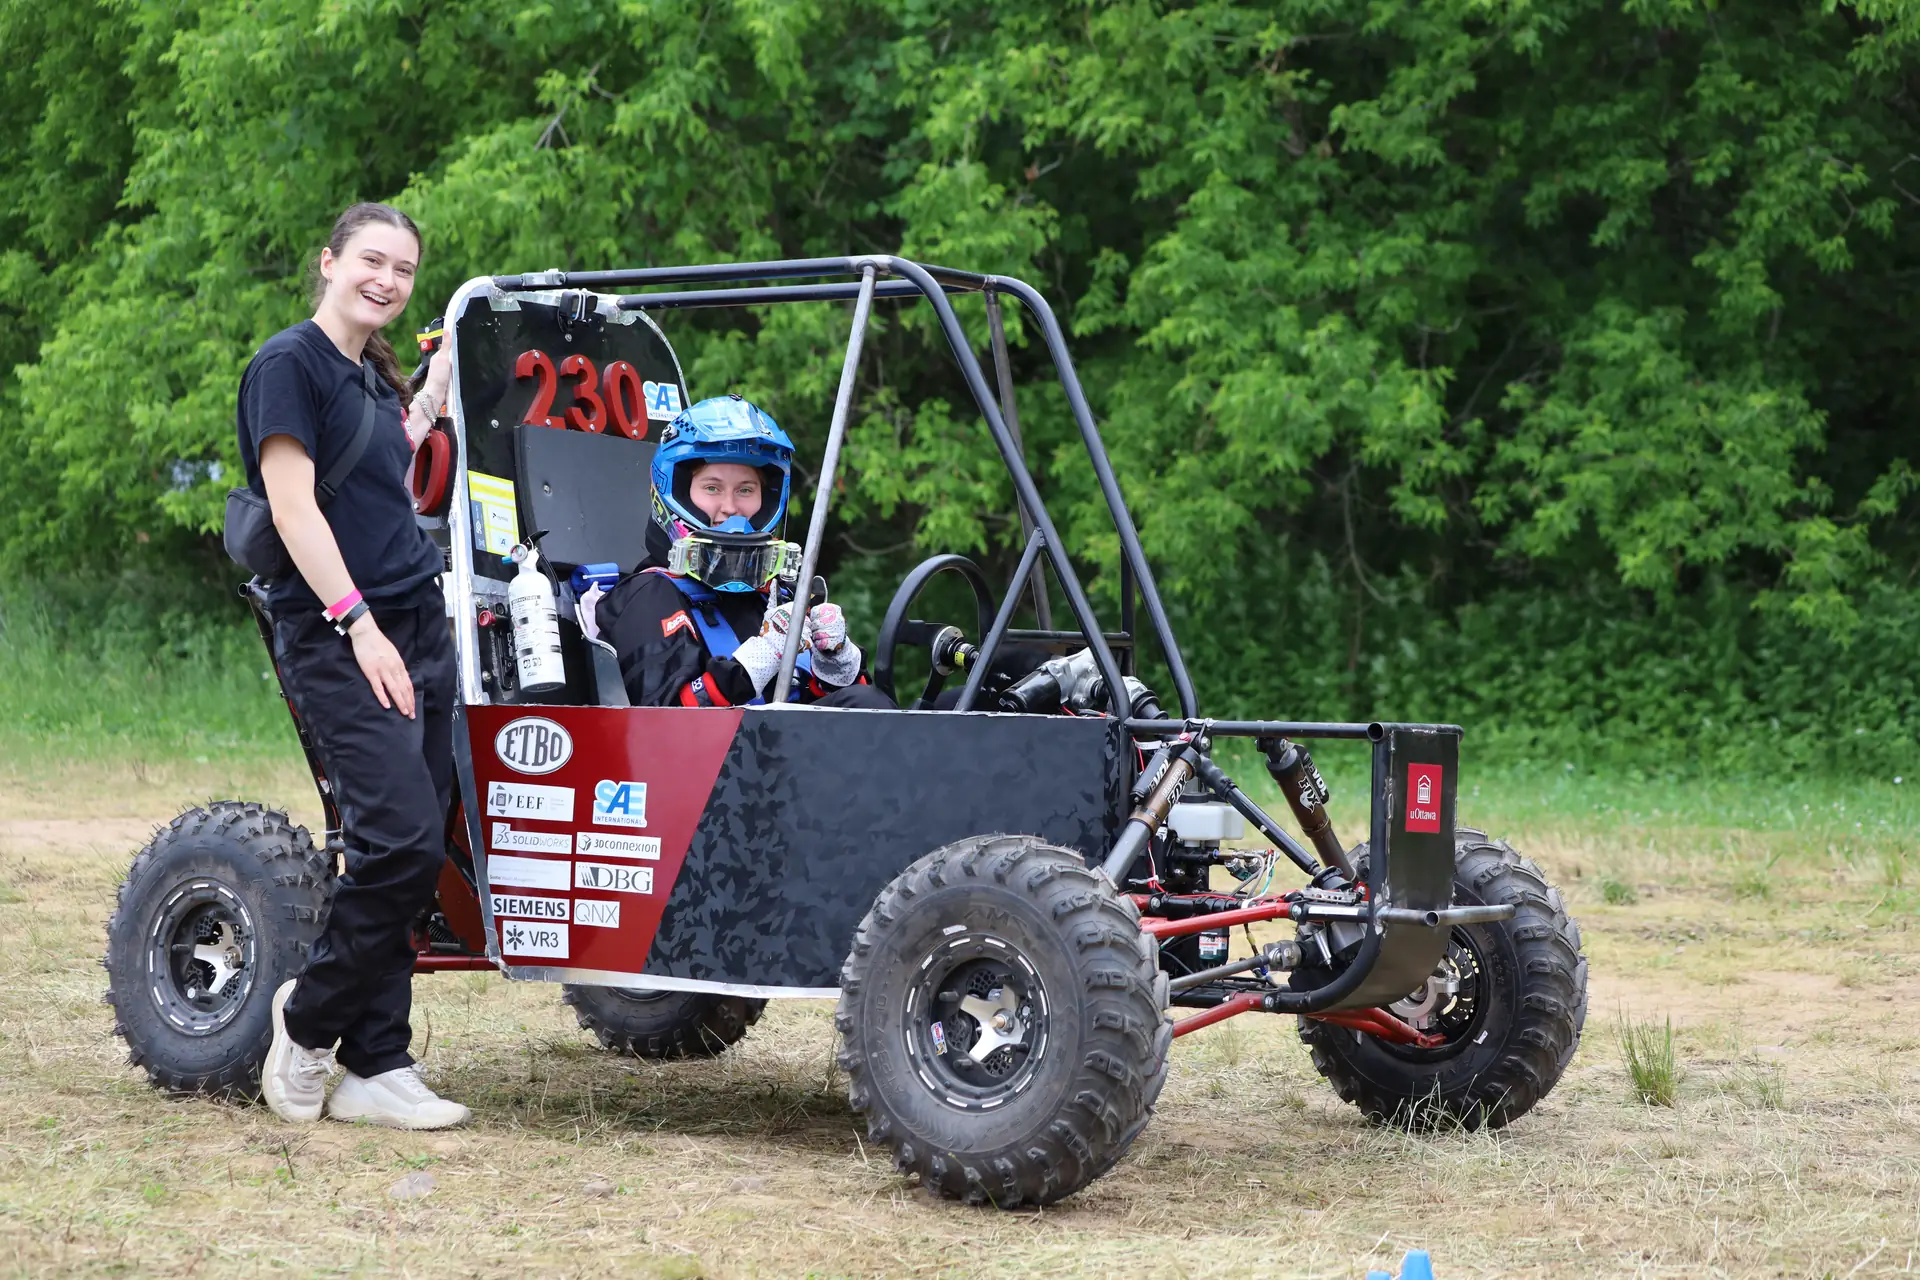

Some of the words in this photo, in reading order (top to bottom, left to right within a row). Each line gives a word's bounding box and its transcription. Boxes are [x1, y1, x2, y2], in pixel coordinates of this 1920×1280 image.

[515, 349, 648, 440] 230
[644, 382, 681, 412] SAE
[503, 725, 563, 766] ETBO
[595, 782, 645, 816] SAE
[1167, 771, 1188, 808] FOX
[1298, 776, 1320, 805] FOX
[516, 795, 544, 810] EEF
[1410, 808, 1437, 820] uOttawa
[595, 816, 643, 825] INTERNATIONAL
[512, 835, 570, 849] SOLIDWORKS
[597, 867, 651, 892] DBG
[493, 898, 566, 917] SIEMENS
[575, 903, 618, 925] QNX
[529, 930, 559, 948] VR3
